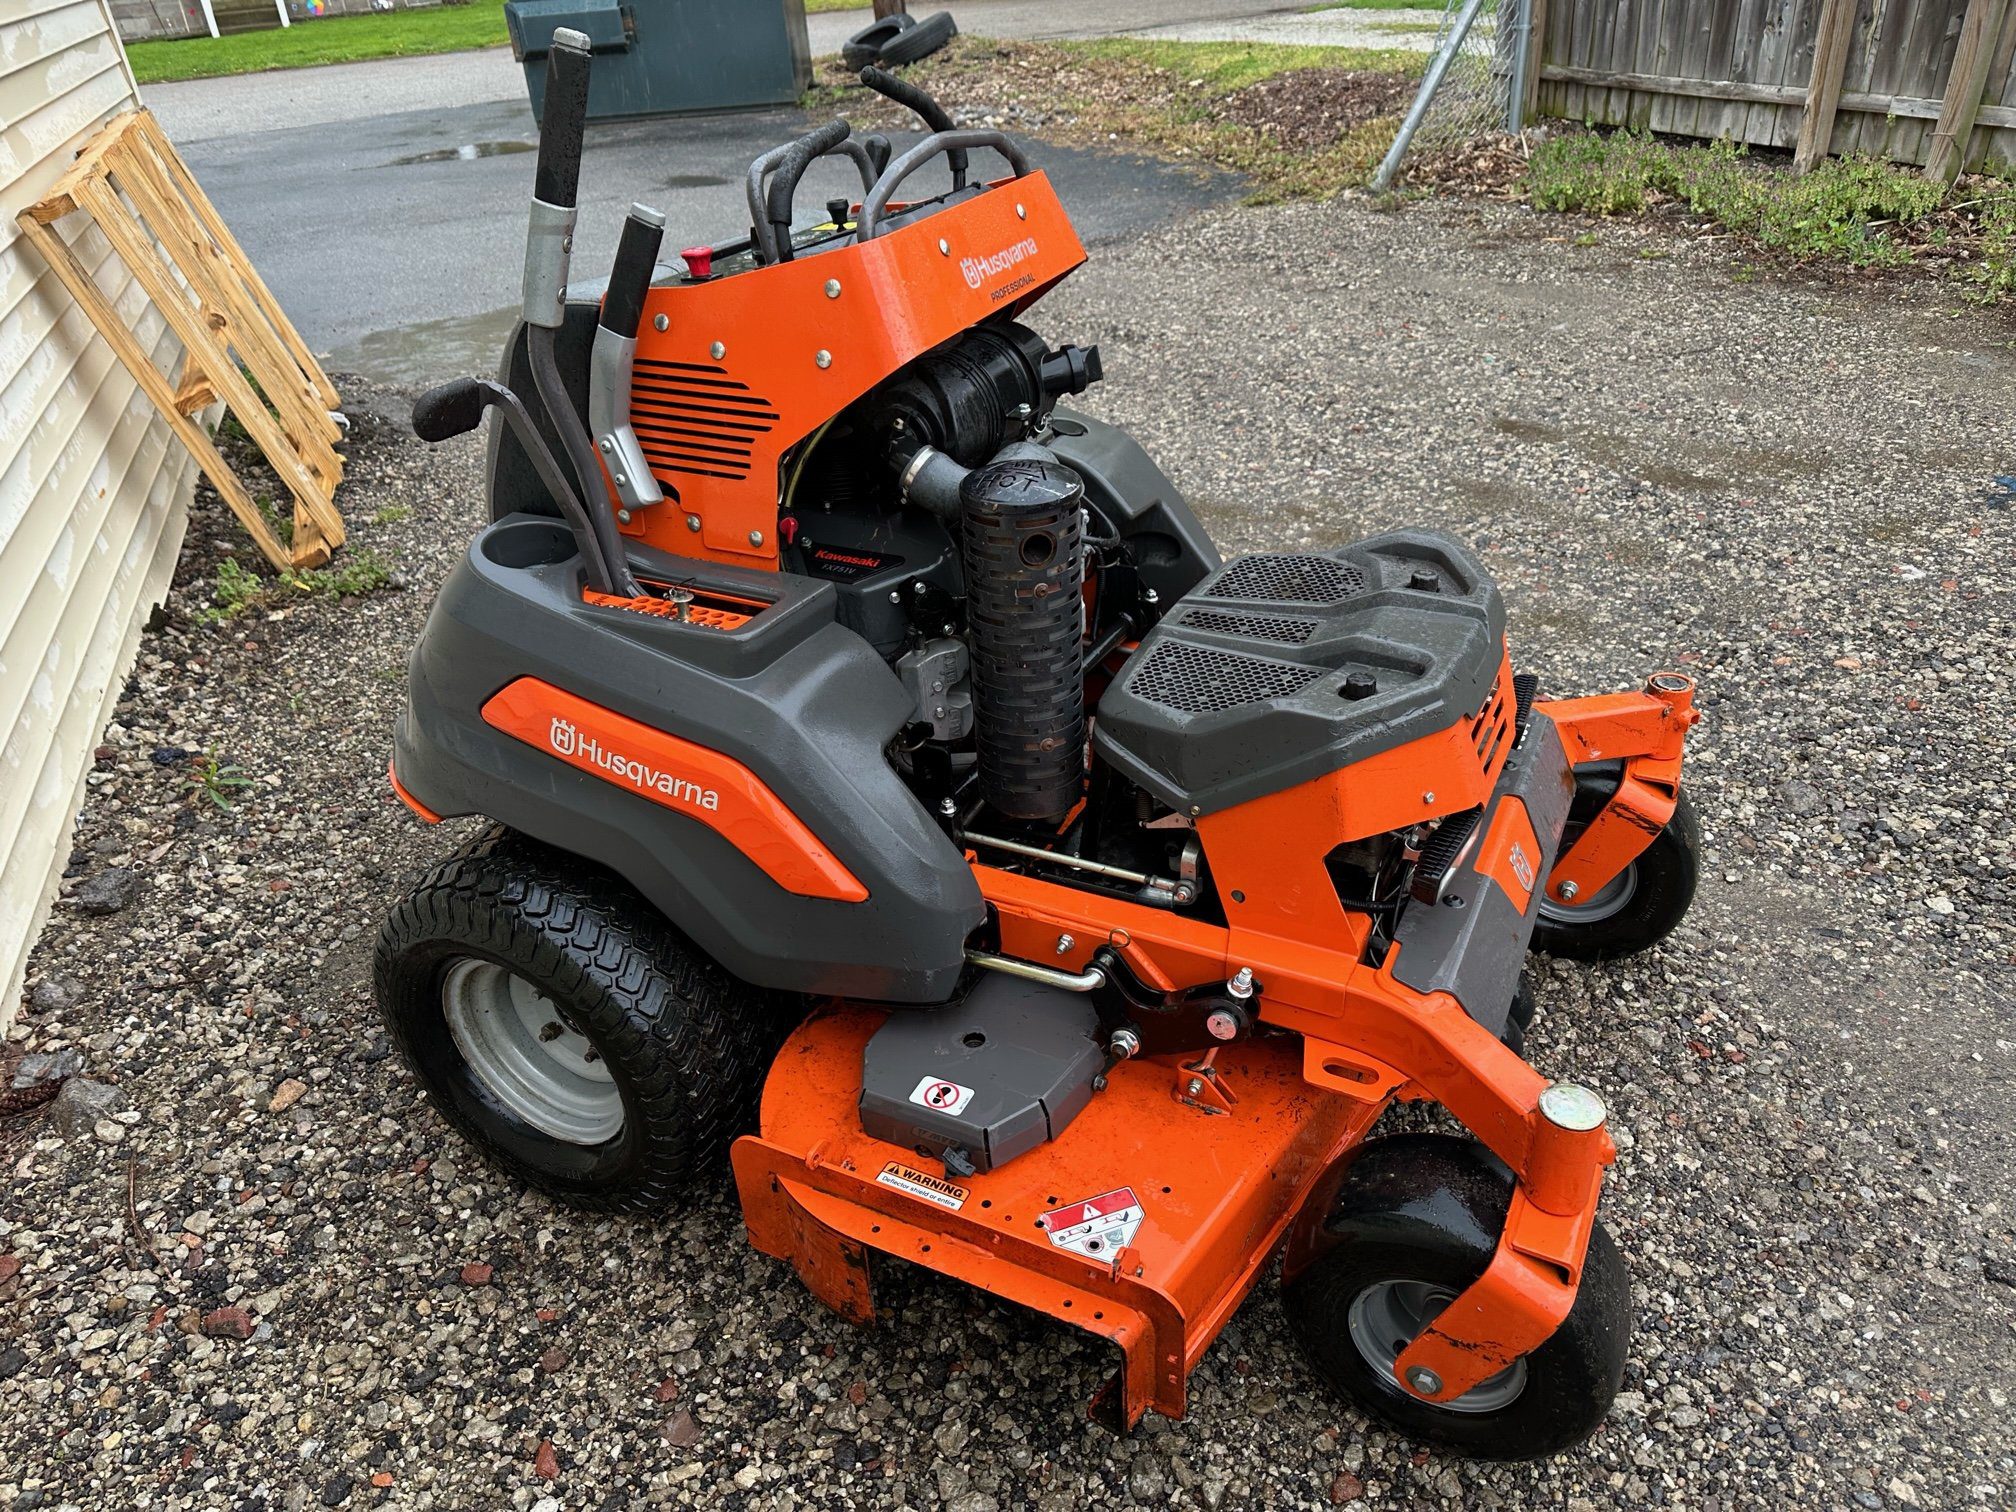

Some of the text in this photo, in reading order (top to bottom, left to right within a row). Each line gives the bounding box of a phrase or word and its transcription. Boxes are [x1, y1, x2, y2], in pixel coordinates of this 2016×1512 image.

[974, 237, 1038, 279] Husqvarna
[990, 273, 1035, 303] PROFESSIONAL
[976, 473, 1039, 492] HOT
[815, 550, 880, 568] Kawasaki
[822, 563, 857, 574] FX751V
[577, 733, 719, 811] Husqvarna
[882, 1175, 909, 1190] Deflector
[910, 1186, 929, 1198] shield
[937, 1196, 956, 1207] entire
[902, 1168, 964, 1198] WARNING
